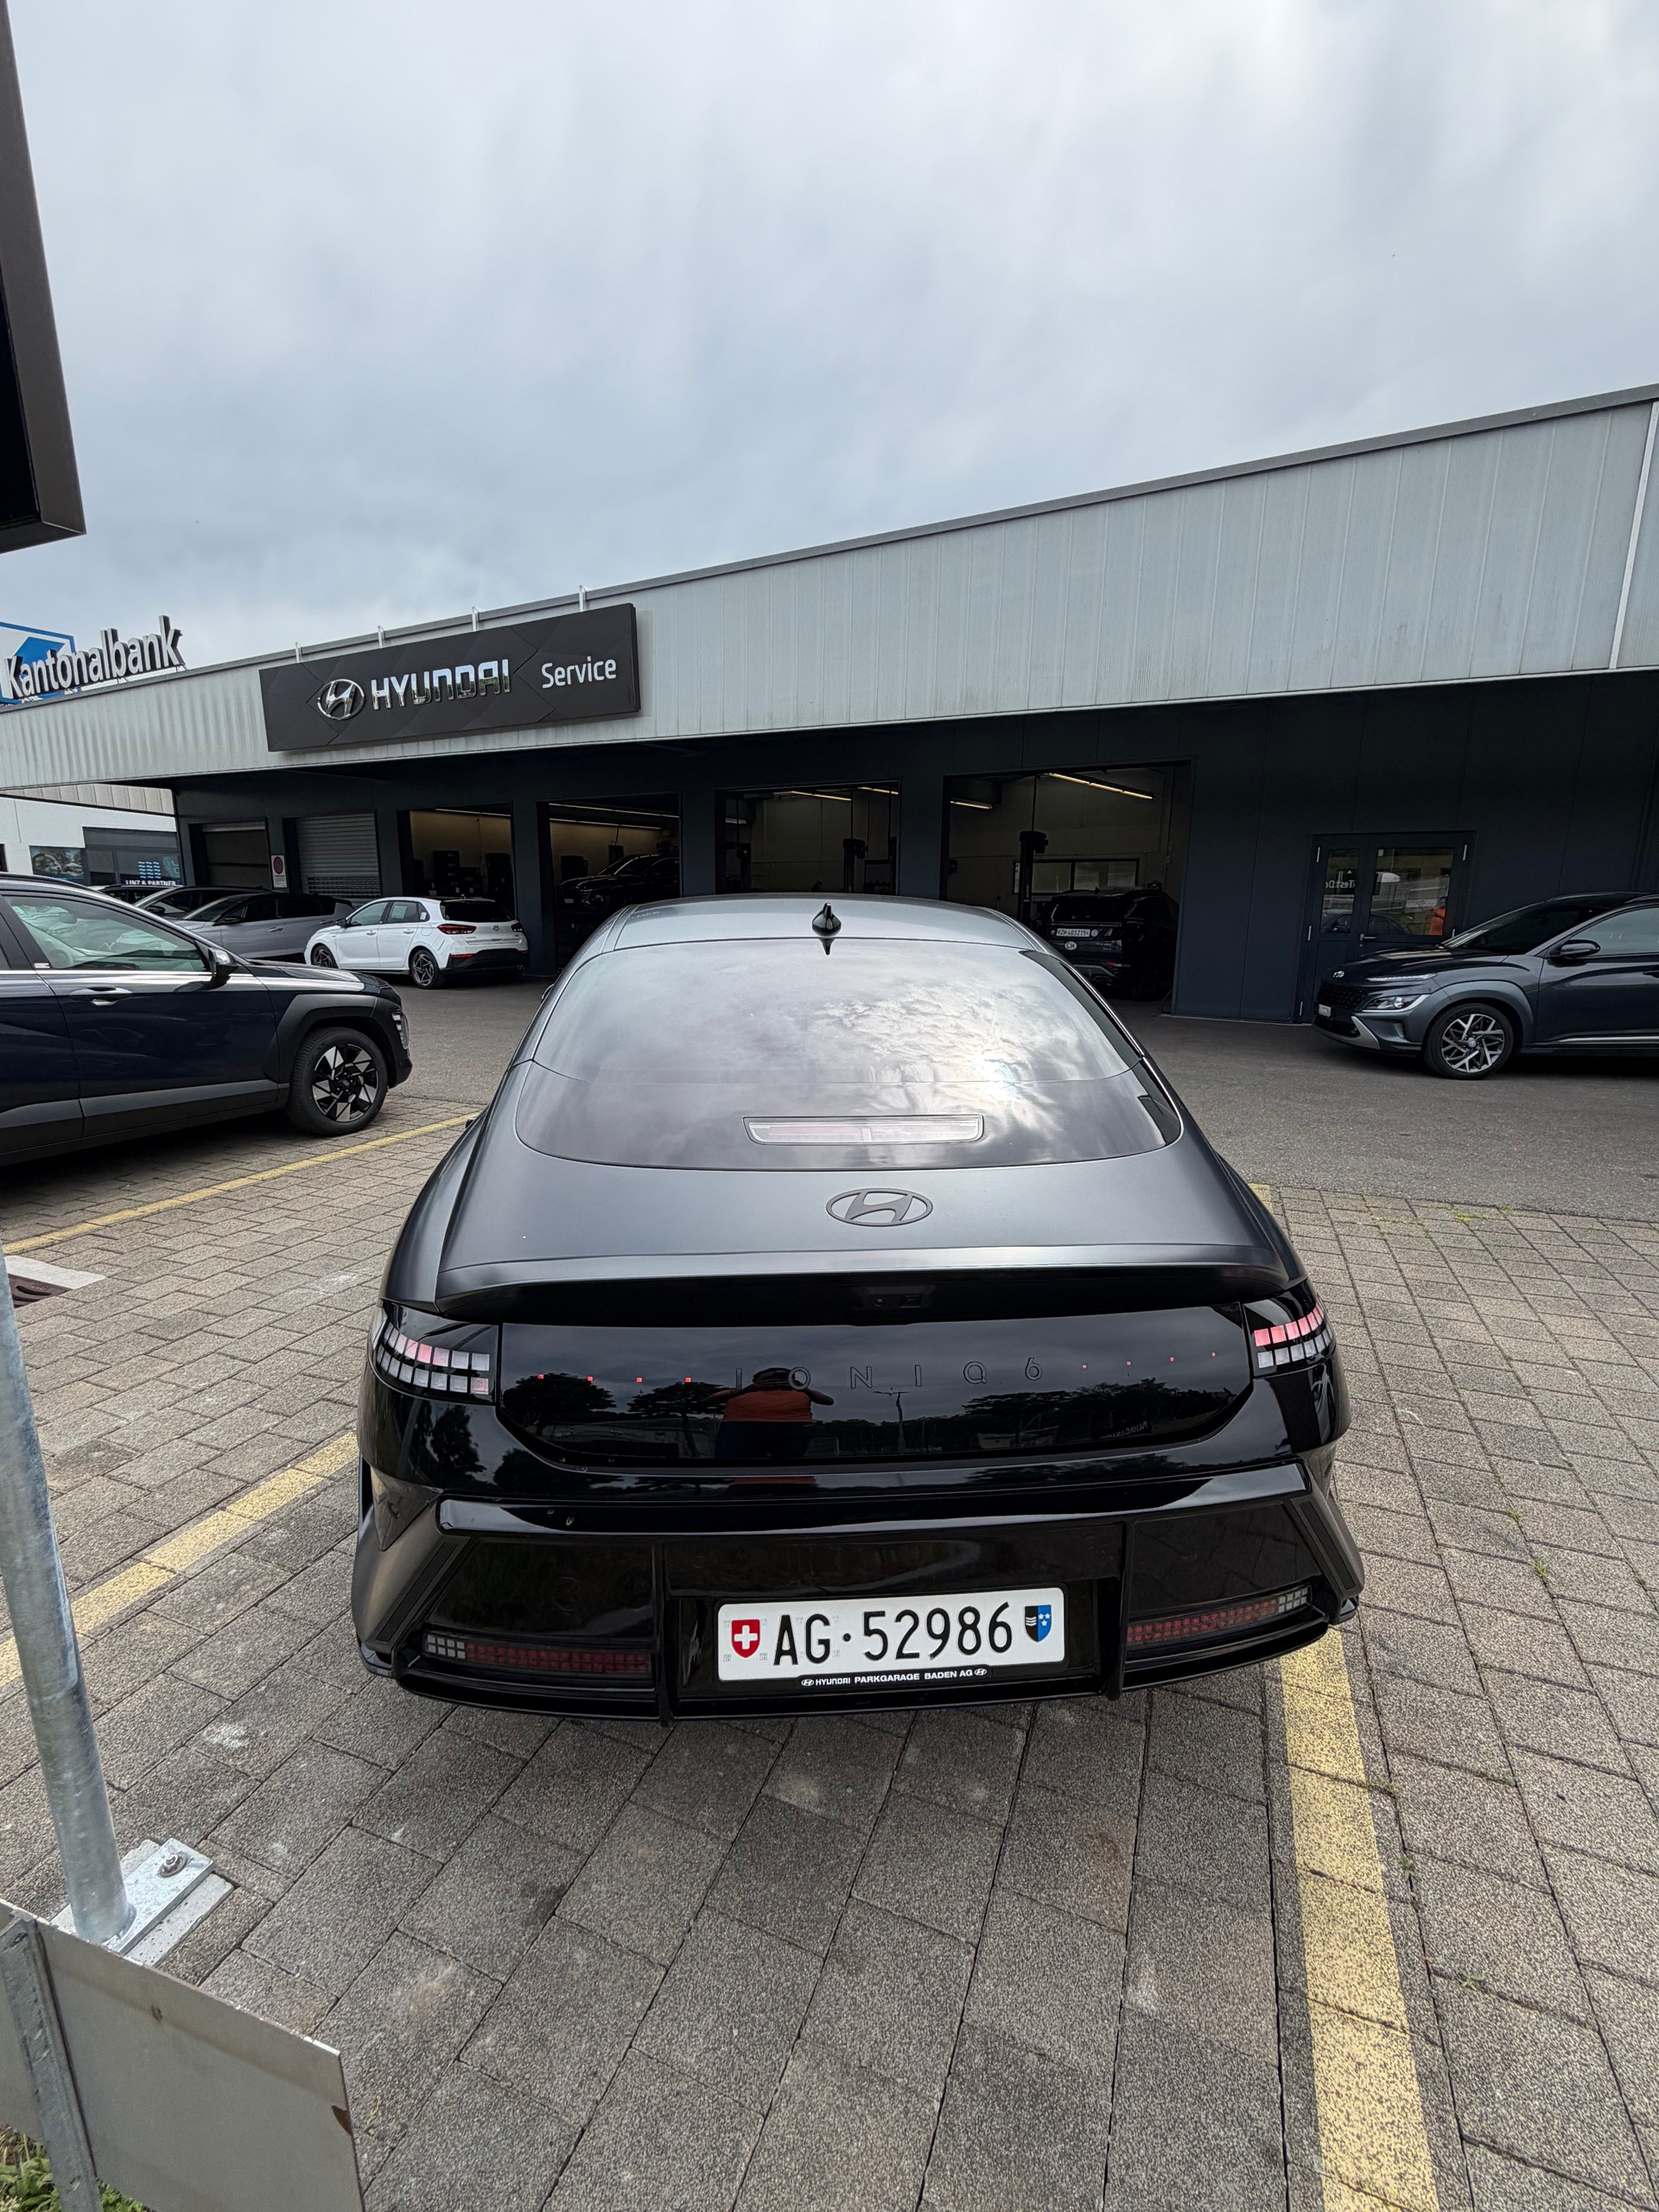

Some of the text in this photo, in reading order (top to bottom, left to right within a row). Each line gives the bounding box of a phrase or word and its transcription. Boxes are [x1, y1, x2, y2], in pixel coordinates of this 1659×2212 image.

[3, 615, 182, 699] Kantonalbank
[371, 656, 617, 709] HYUNDAI Service
[815, 1669, 973, 1686] HYUNDAI PARKGARAGE BADEN AG
